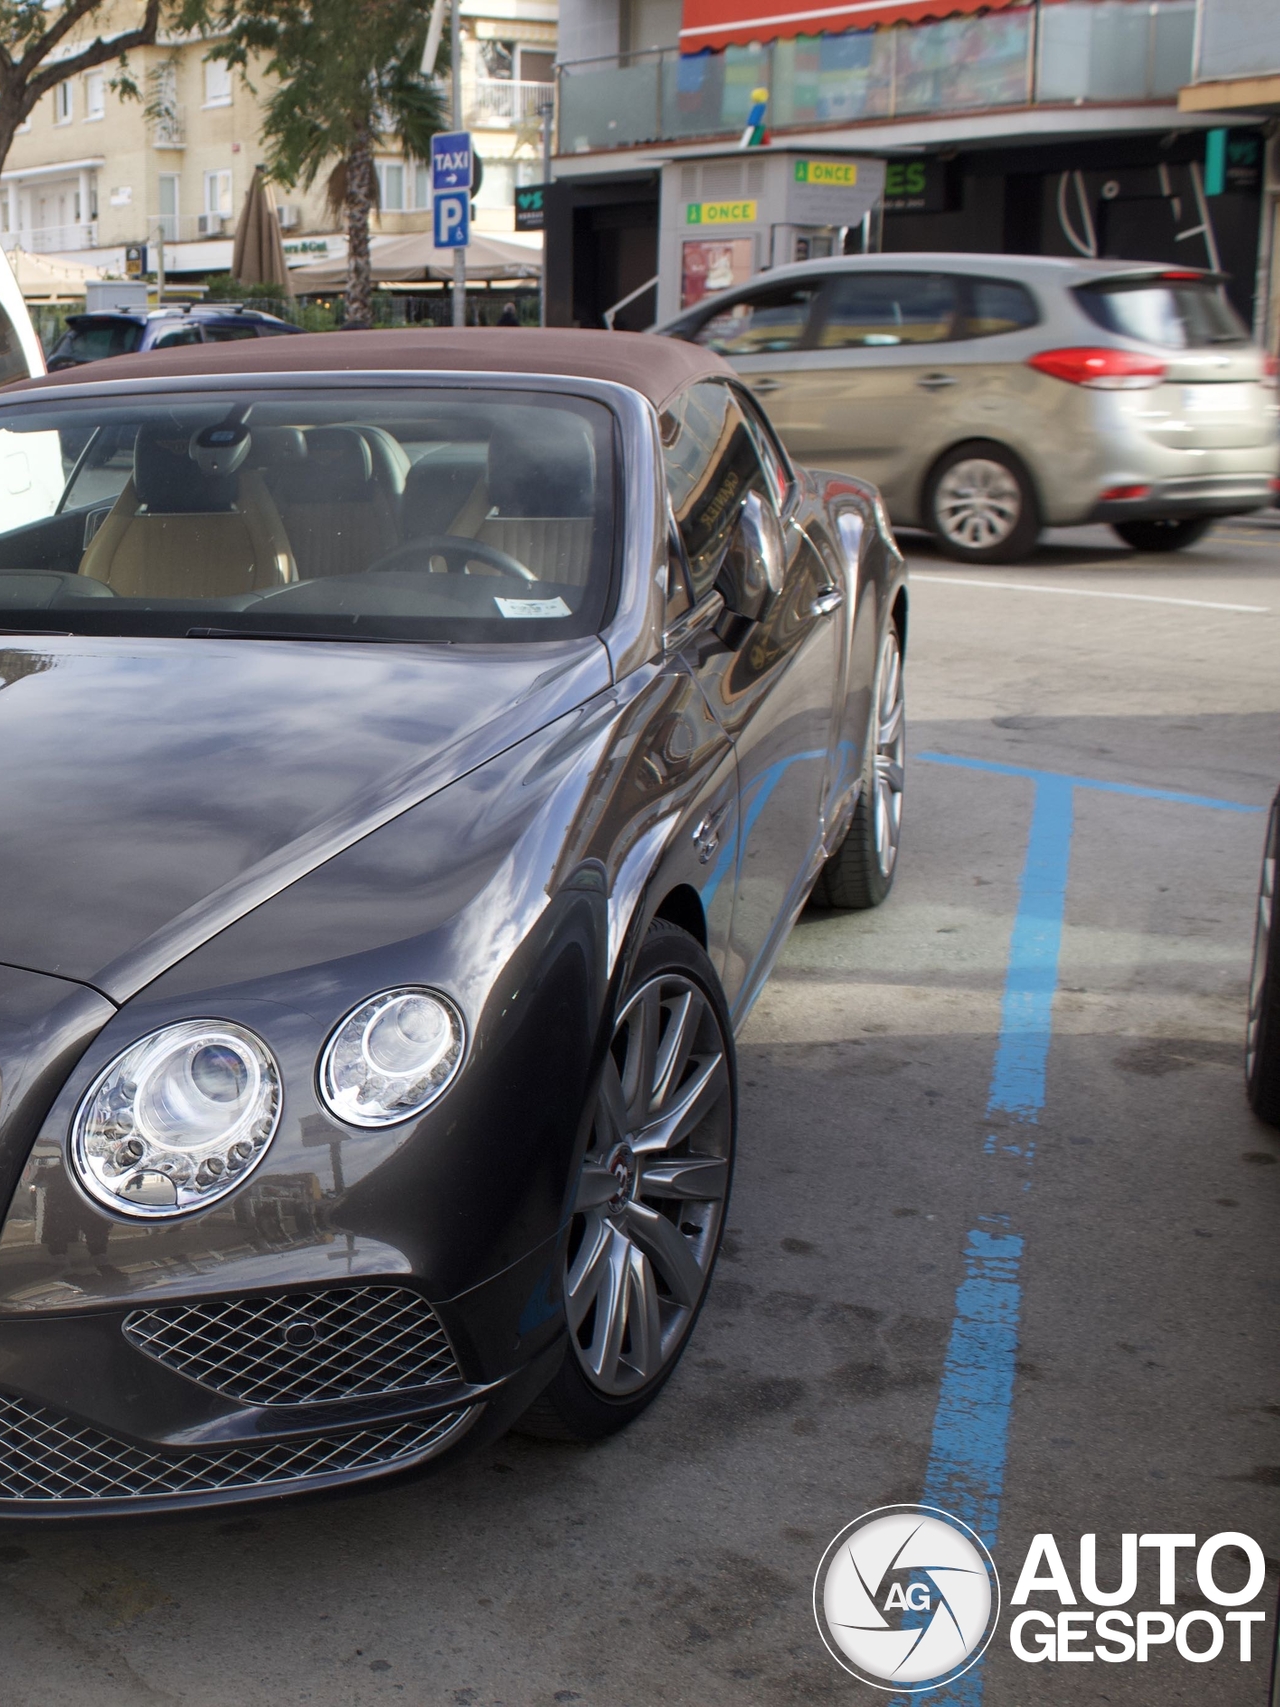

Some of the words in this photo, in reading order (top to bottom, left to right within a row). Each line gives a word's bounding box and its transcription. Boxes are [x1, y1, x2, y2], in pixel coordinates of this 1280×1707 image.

[435, 151, 469, 171] TAXI
[813, 165, 852, 182] ONCE
[886, 162, 926, 195] ES
[440, 198, 462, 242] P
[707, 204, 750, 220] ONCE
